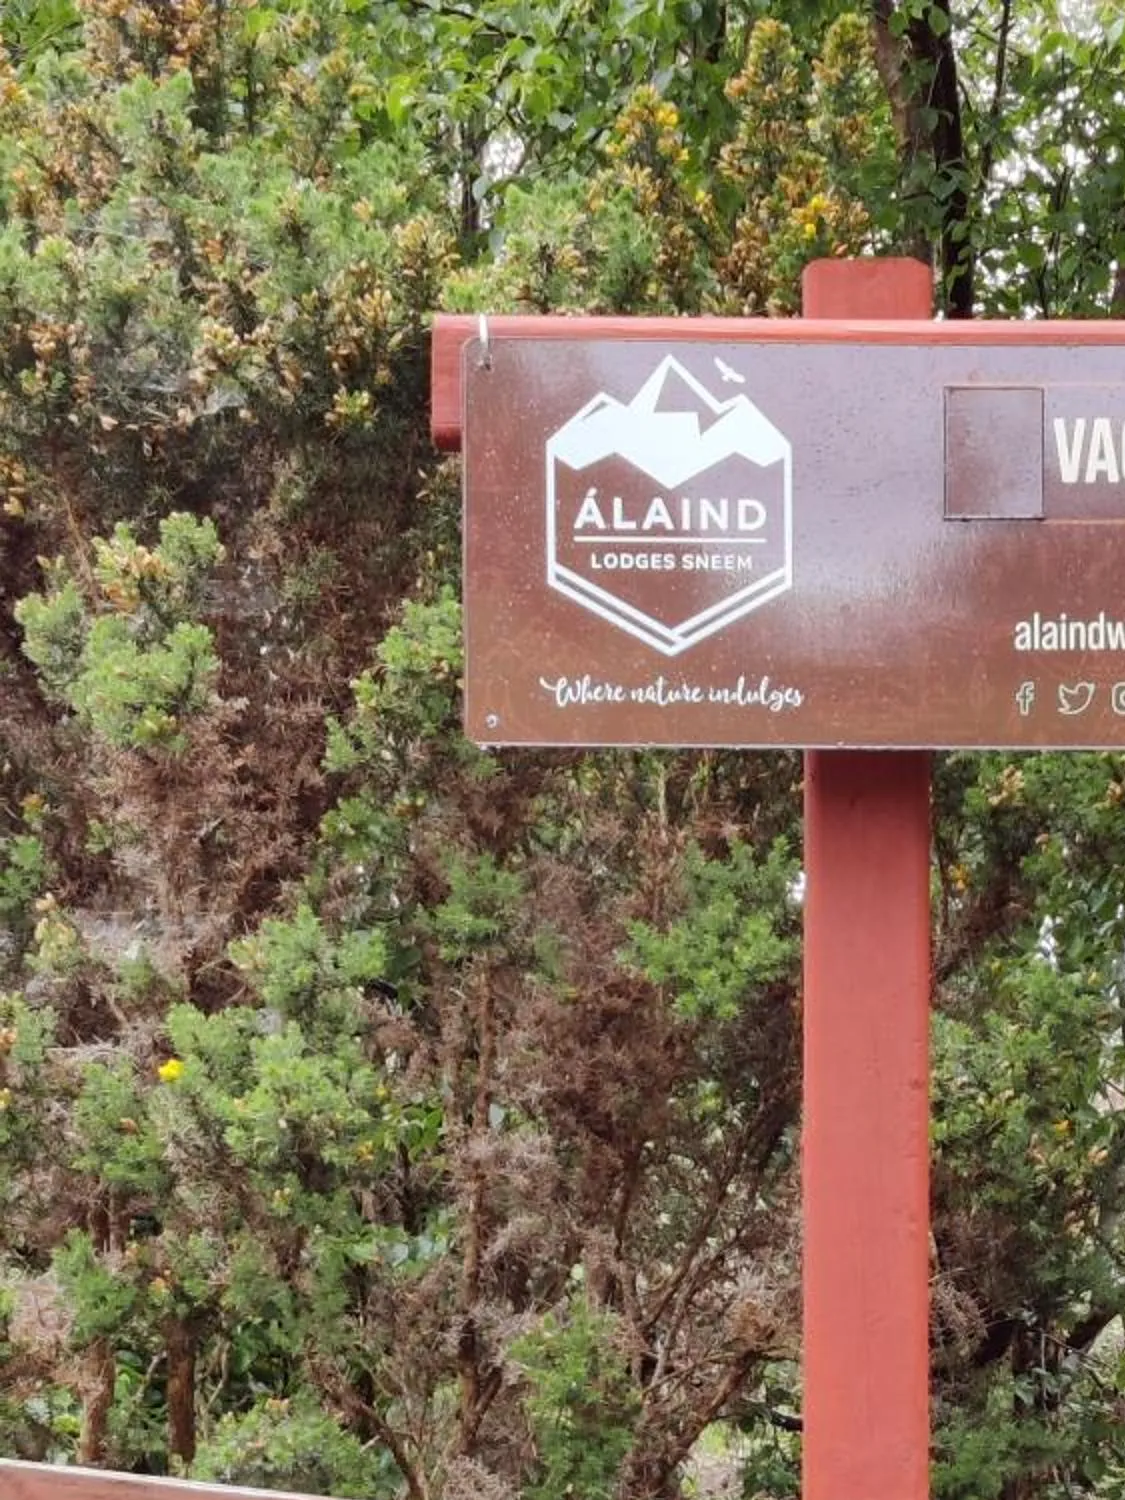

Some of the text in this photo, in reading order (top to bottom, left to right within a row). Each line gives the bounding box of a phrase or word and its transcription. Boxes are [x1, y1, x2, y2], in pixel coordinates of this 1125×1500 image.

[574, 488, 767, 531] ÁLAIND
[590, 553, 753, 570] LODGES SNEEM
[539, 675, 804, 713] Where nature indulges
